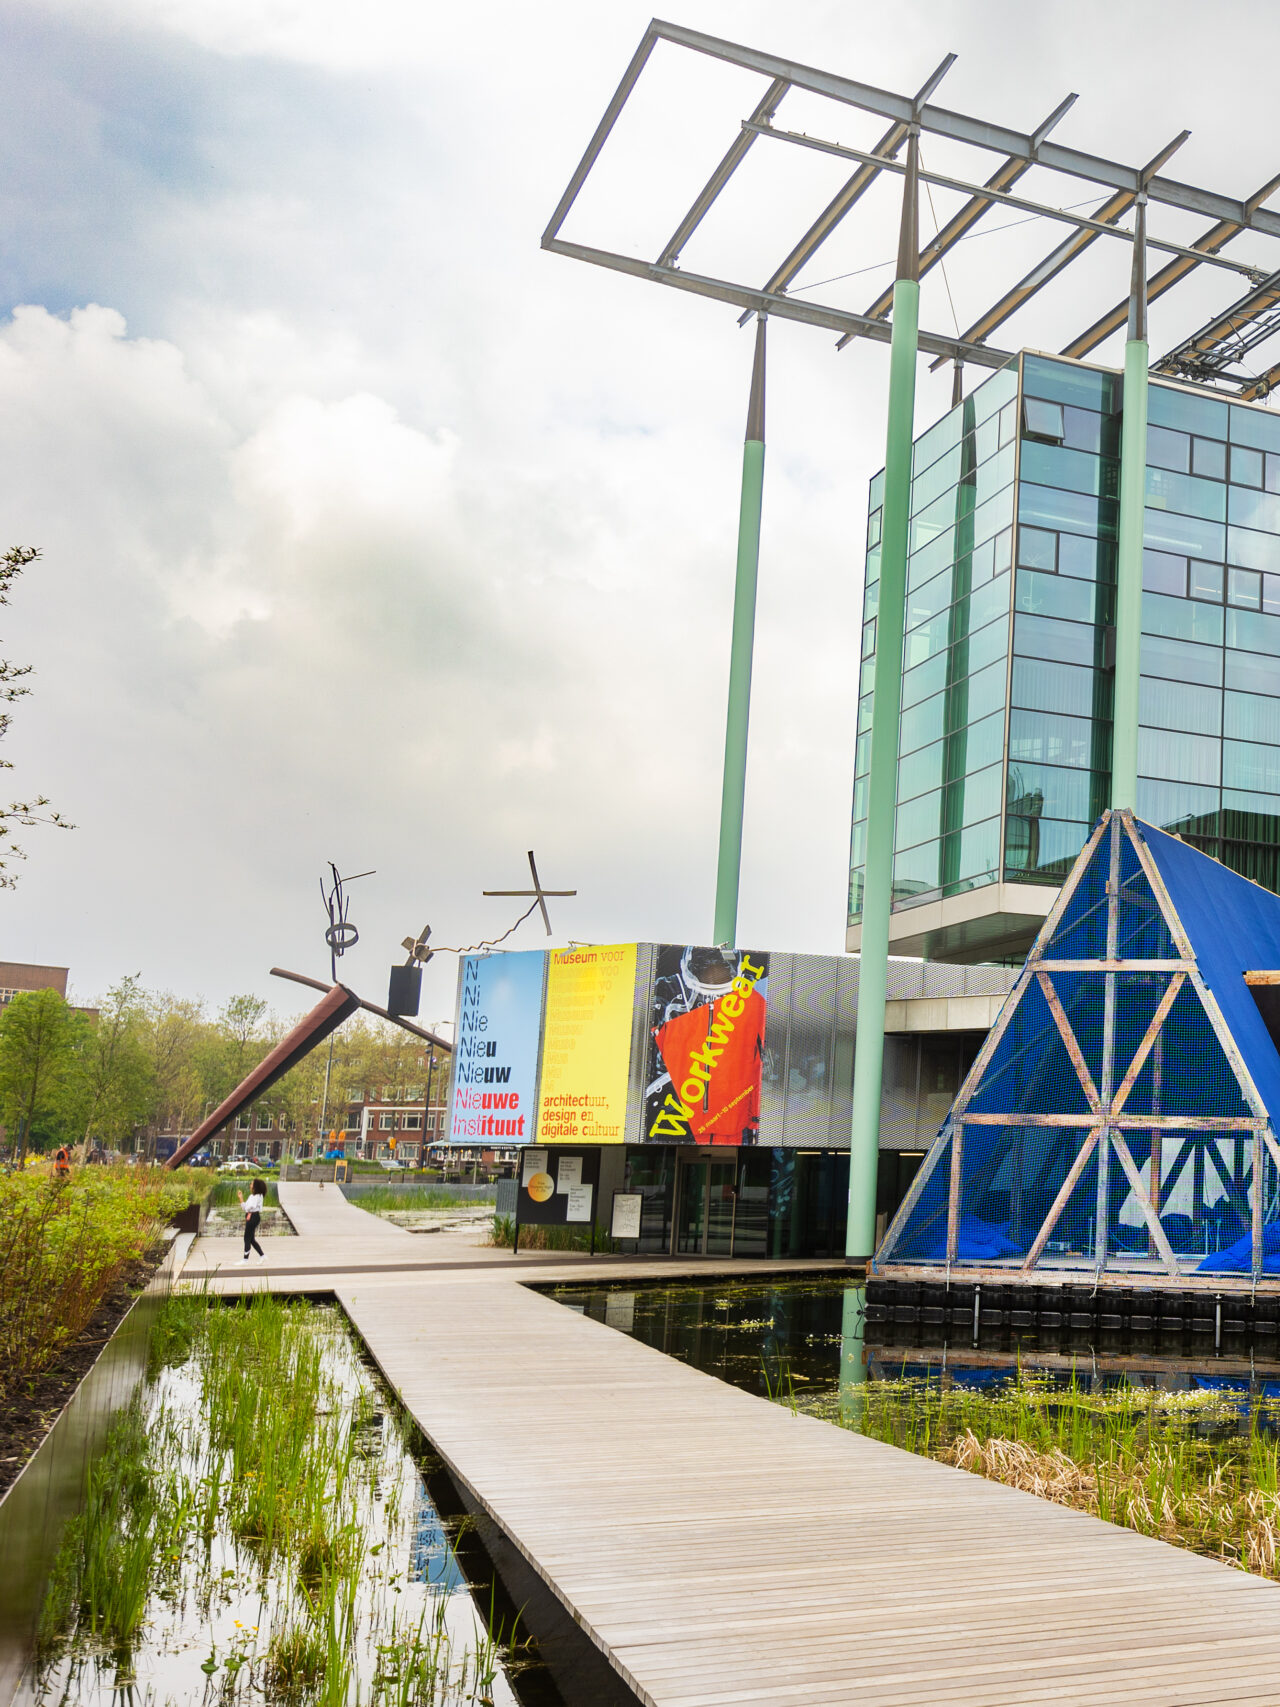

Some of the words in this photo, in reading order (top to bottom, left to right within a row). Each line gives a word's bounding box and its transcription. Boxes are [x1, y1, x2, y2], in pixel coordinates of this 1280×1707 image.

[553, 952, 597, 965] Museum
[601, 951, 625, 962] voor
[466, 960, 479, 981] N
[464, 985, 481, 1007] Ni
[462, 1011, 488, 1032] Nie
[460, 1036, 497, 1058] Nieu
[649, 954, 765, 1138] Workwear
[458, 1062, 511, 1084] Nieuw
[455, 1087, 519, 1110] Nieuwe
[543, 1093, 609, 1110] architectuur,
[728, 1085, 753, 1108] september
[453, 1114, 525, 1137] Instituut
[542, 1108, 576, 1124] design
[581, 1111, 594, 1122] en
[541, 1122, 578, 1139] digitale
[582, 1121, 620, 1137] cultuur
